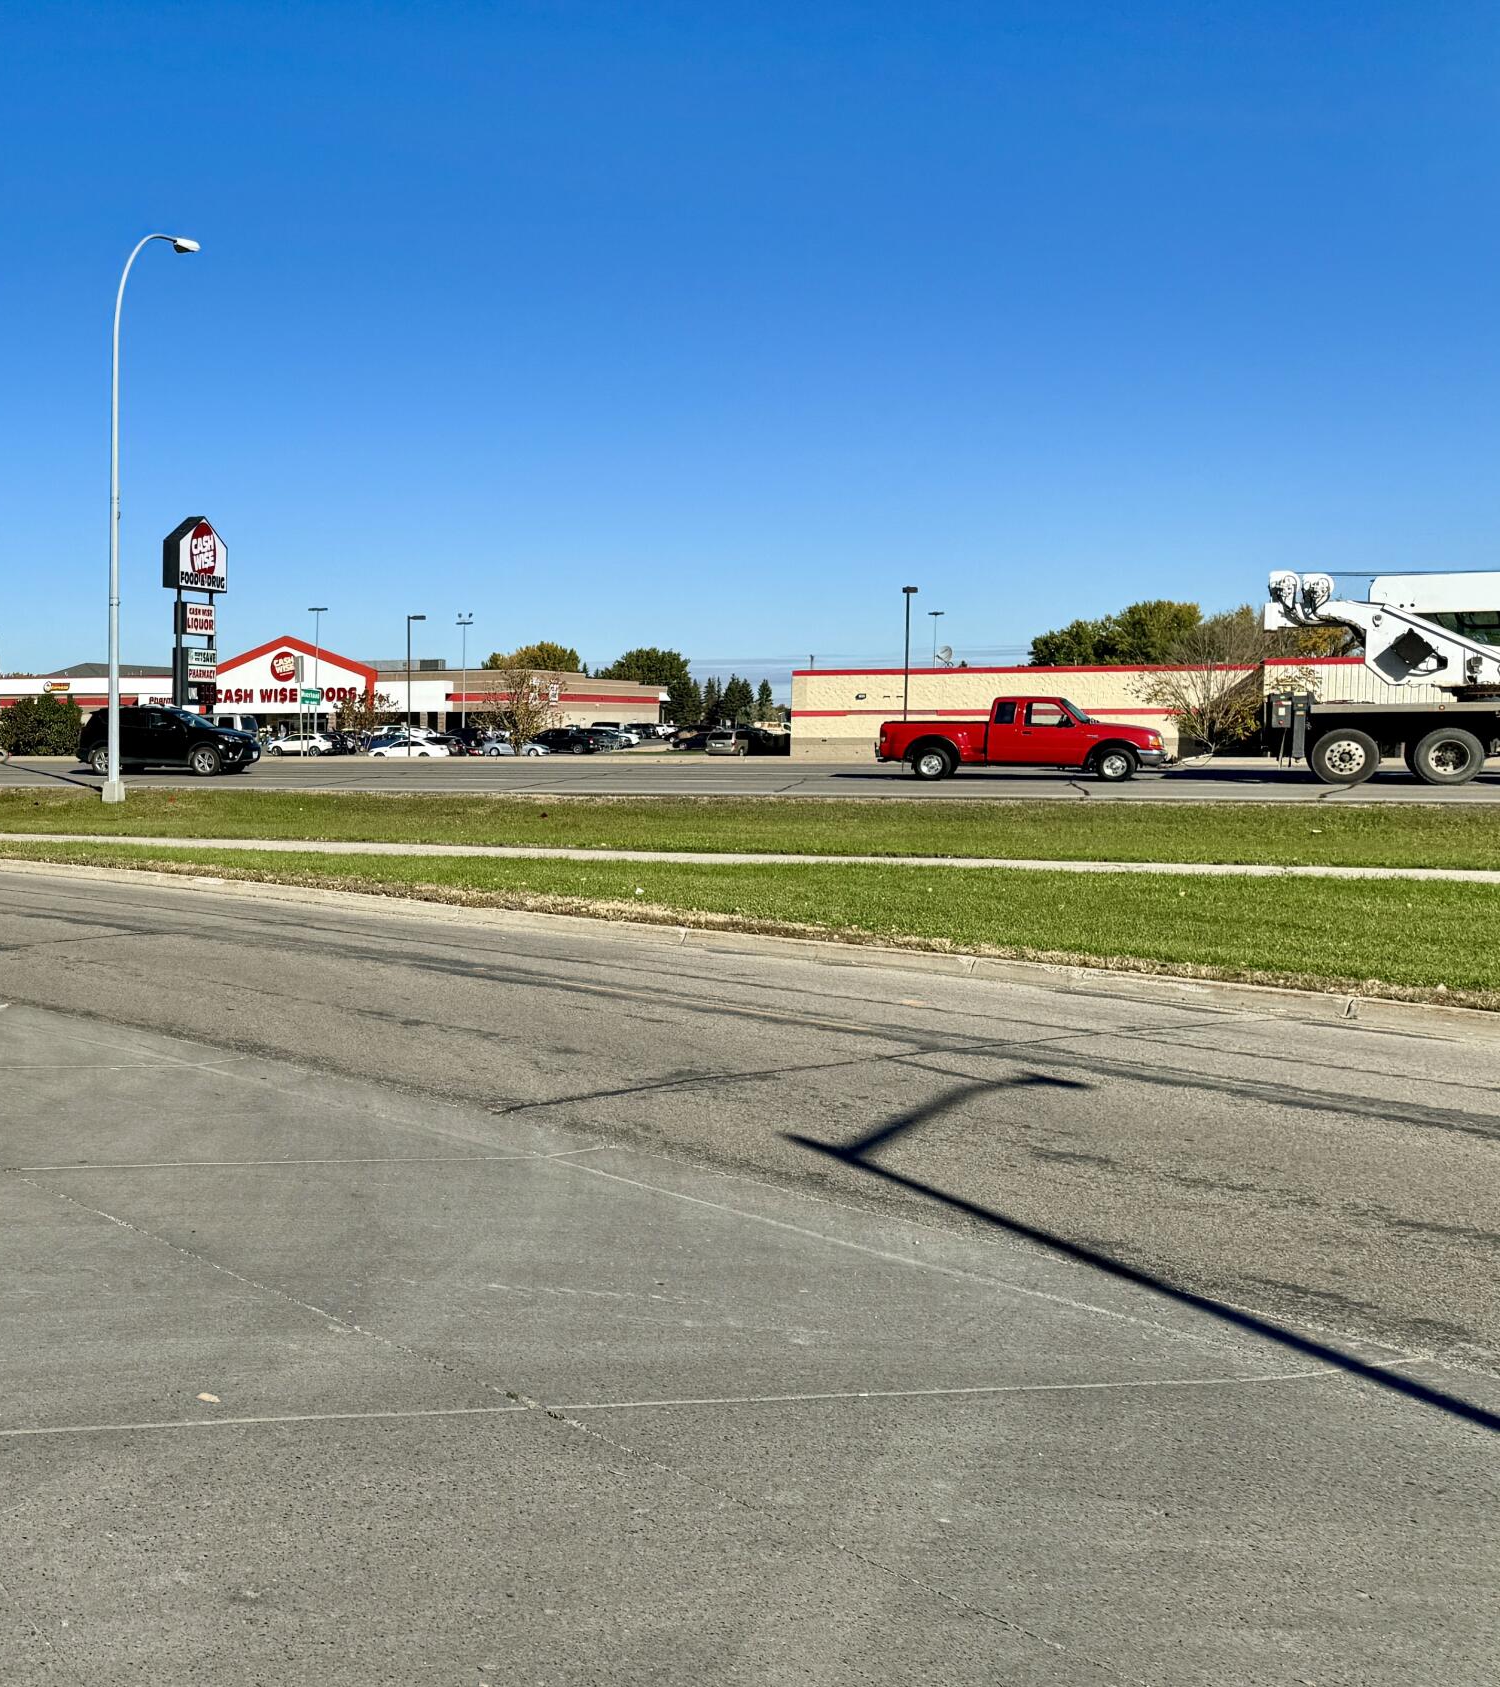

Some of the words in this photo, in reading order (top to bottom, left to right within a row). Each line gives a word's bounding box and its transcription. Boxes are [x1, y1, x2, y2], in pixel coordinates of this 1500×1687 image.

[180, 571, 199, 585] FOOD
[200, 573, 205, 586] &
[207, 574, 225, 589] DRUG
[187, 617, 213, 631] LIQUOR
[203, 651, 216, 663] SAVE
[189, 668, 216, 679] PHARMACY
